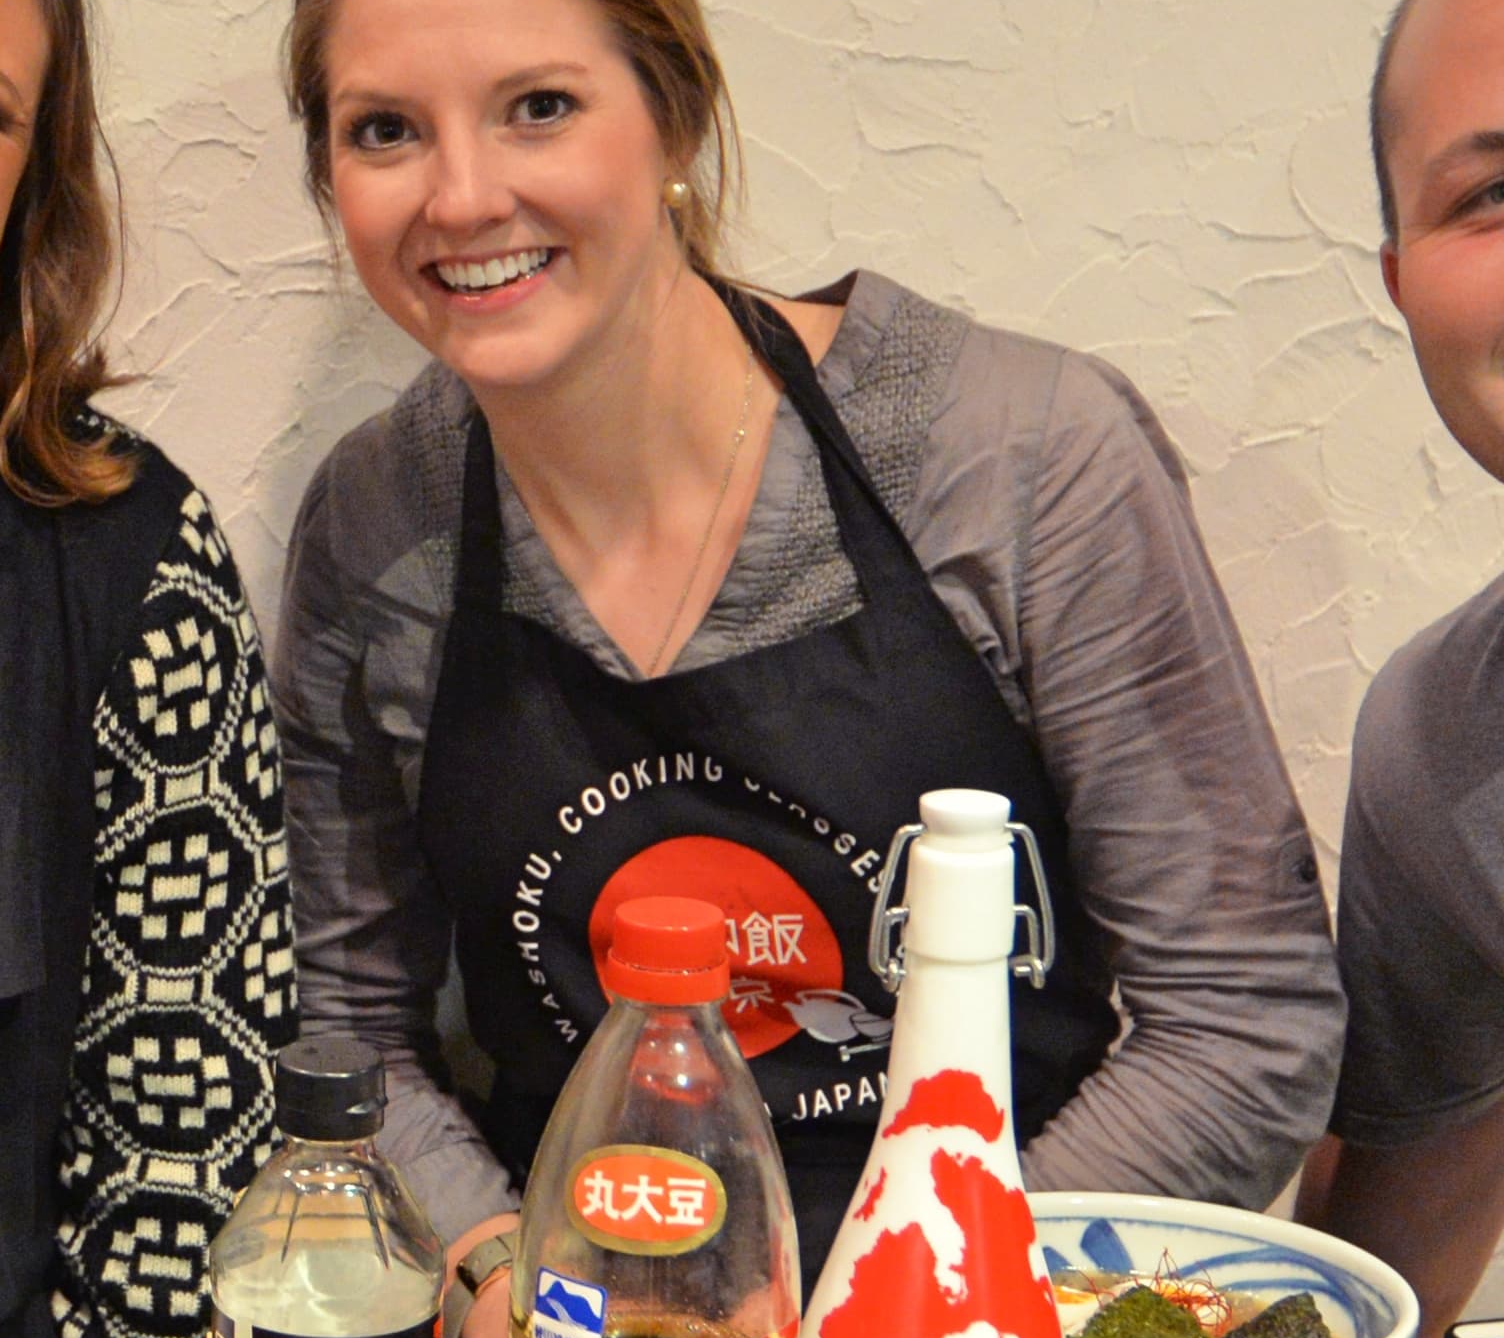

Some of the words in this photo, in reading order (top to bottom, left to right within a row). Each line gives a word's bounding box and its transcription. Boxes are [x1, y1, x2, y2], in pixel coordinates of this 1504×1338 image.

[558, 751, 723, 834] COOKING
[582, 1170, 707, 1227] 丸大豆
